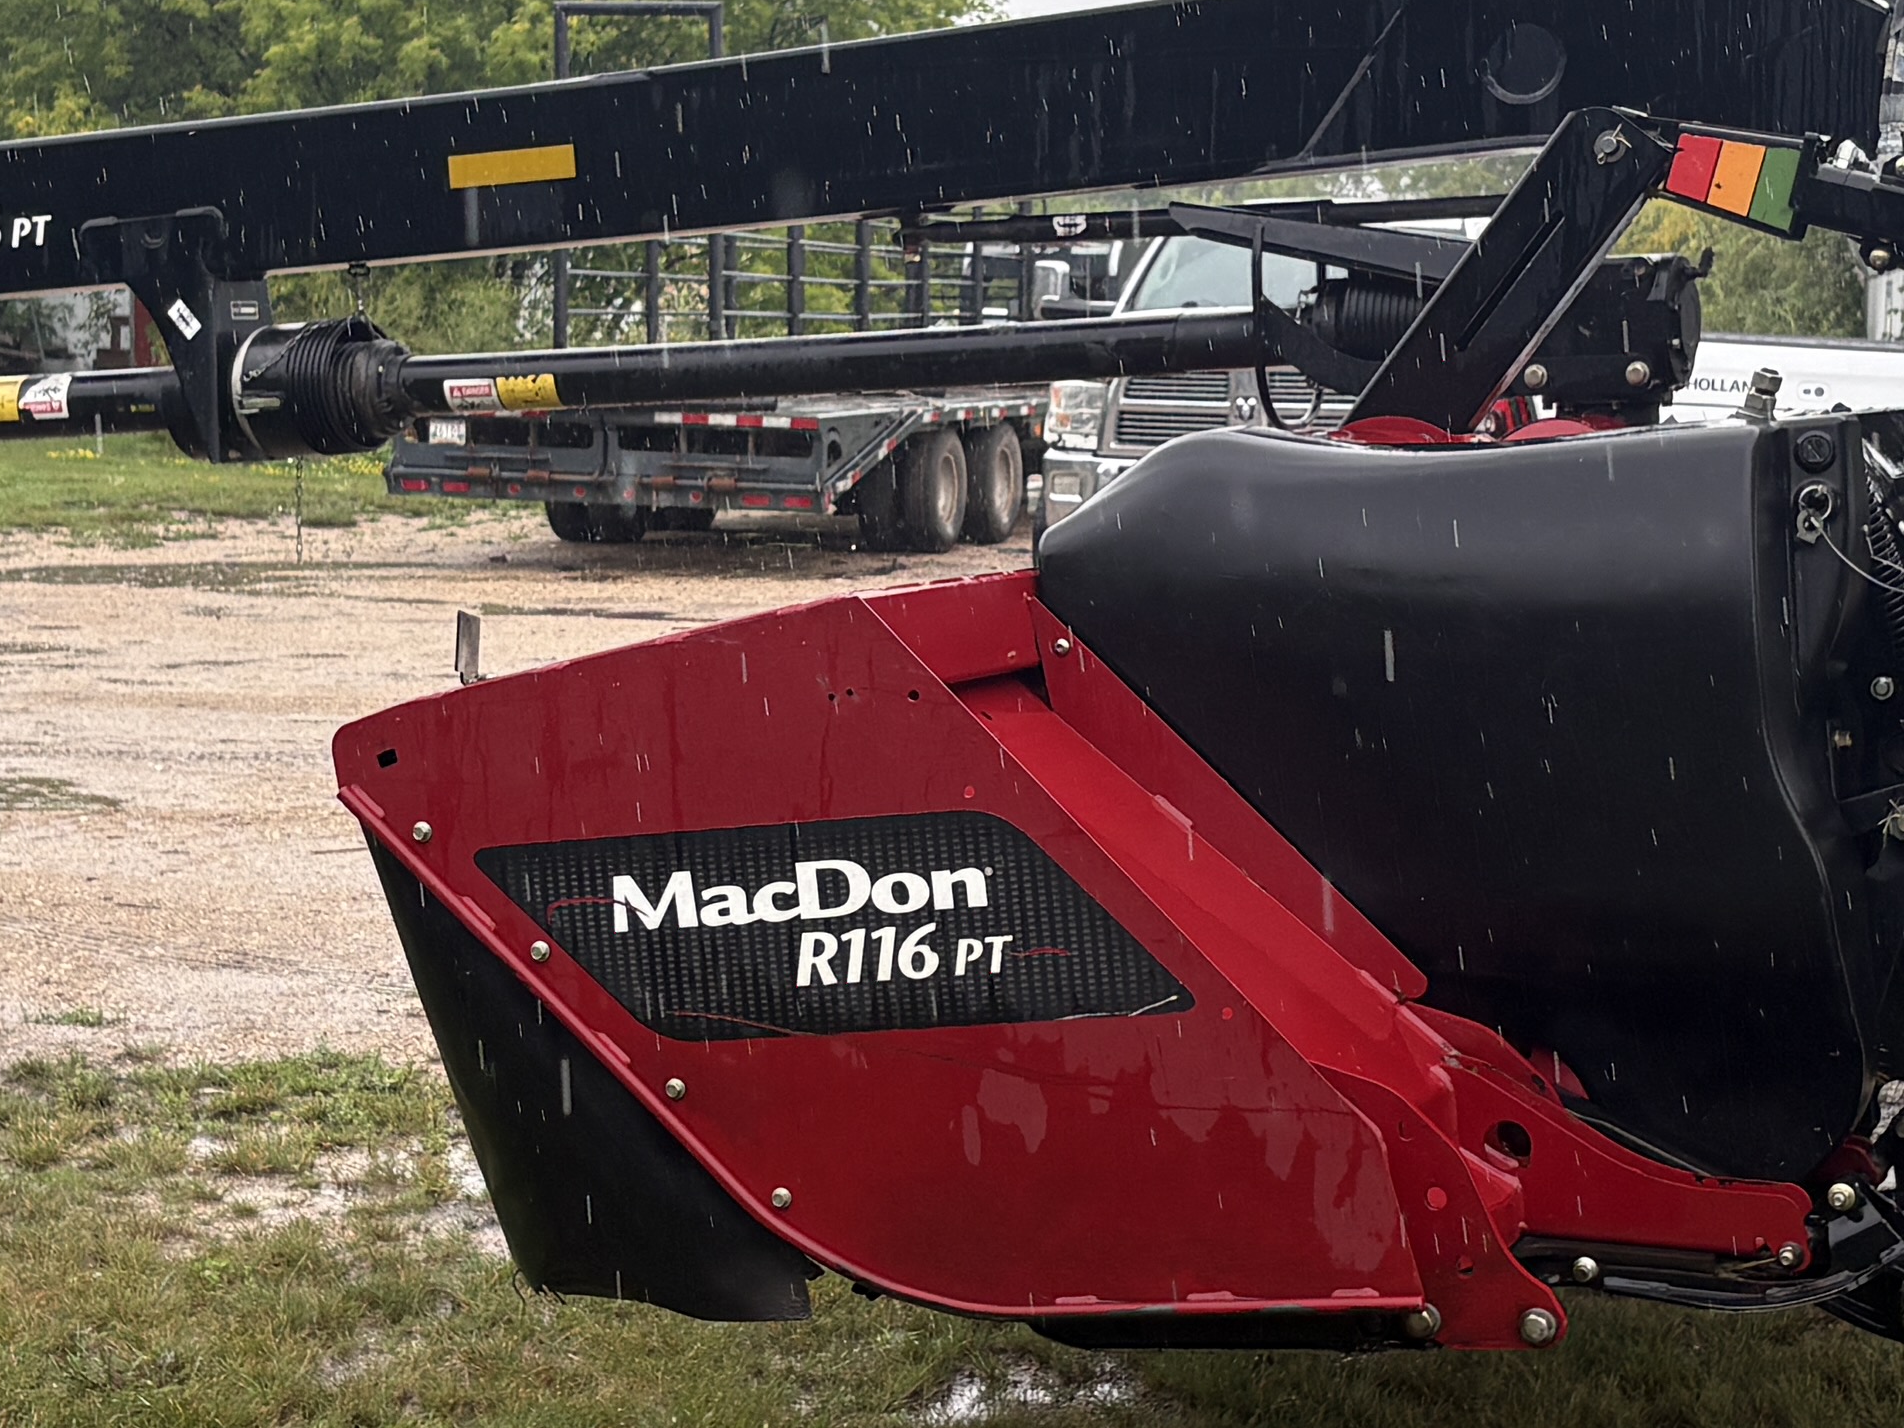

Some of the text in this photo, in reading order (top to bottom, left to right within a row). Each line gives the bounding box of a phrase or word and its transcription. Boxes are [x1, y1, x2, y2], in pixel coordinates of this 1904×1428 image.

[11, 214, 52, 249] PT
[1686, 377, 1750, 393] HOLLAN
[612, 859, 989, 933] MacDon
[796, 922, 1014, 988] R116 PT
